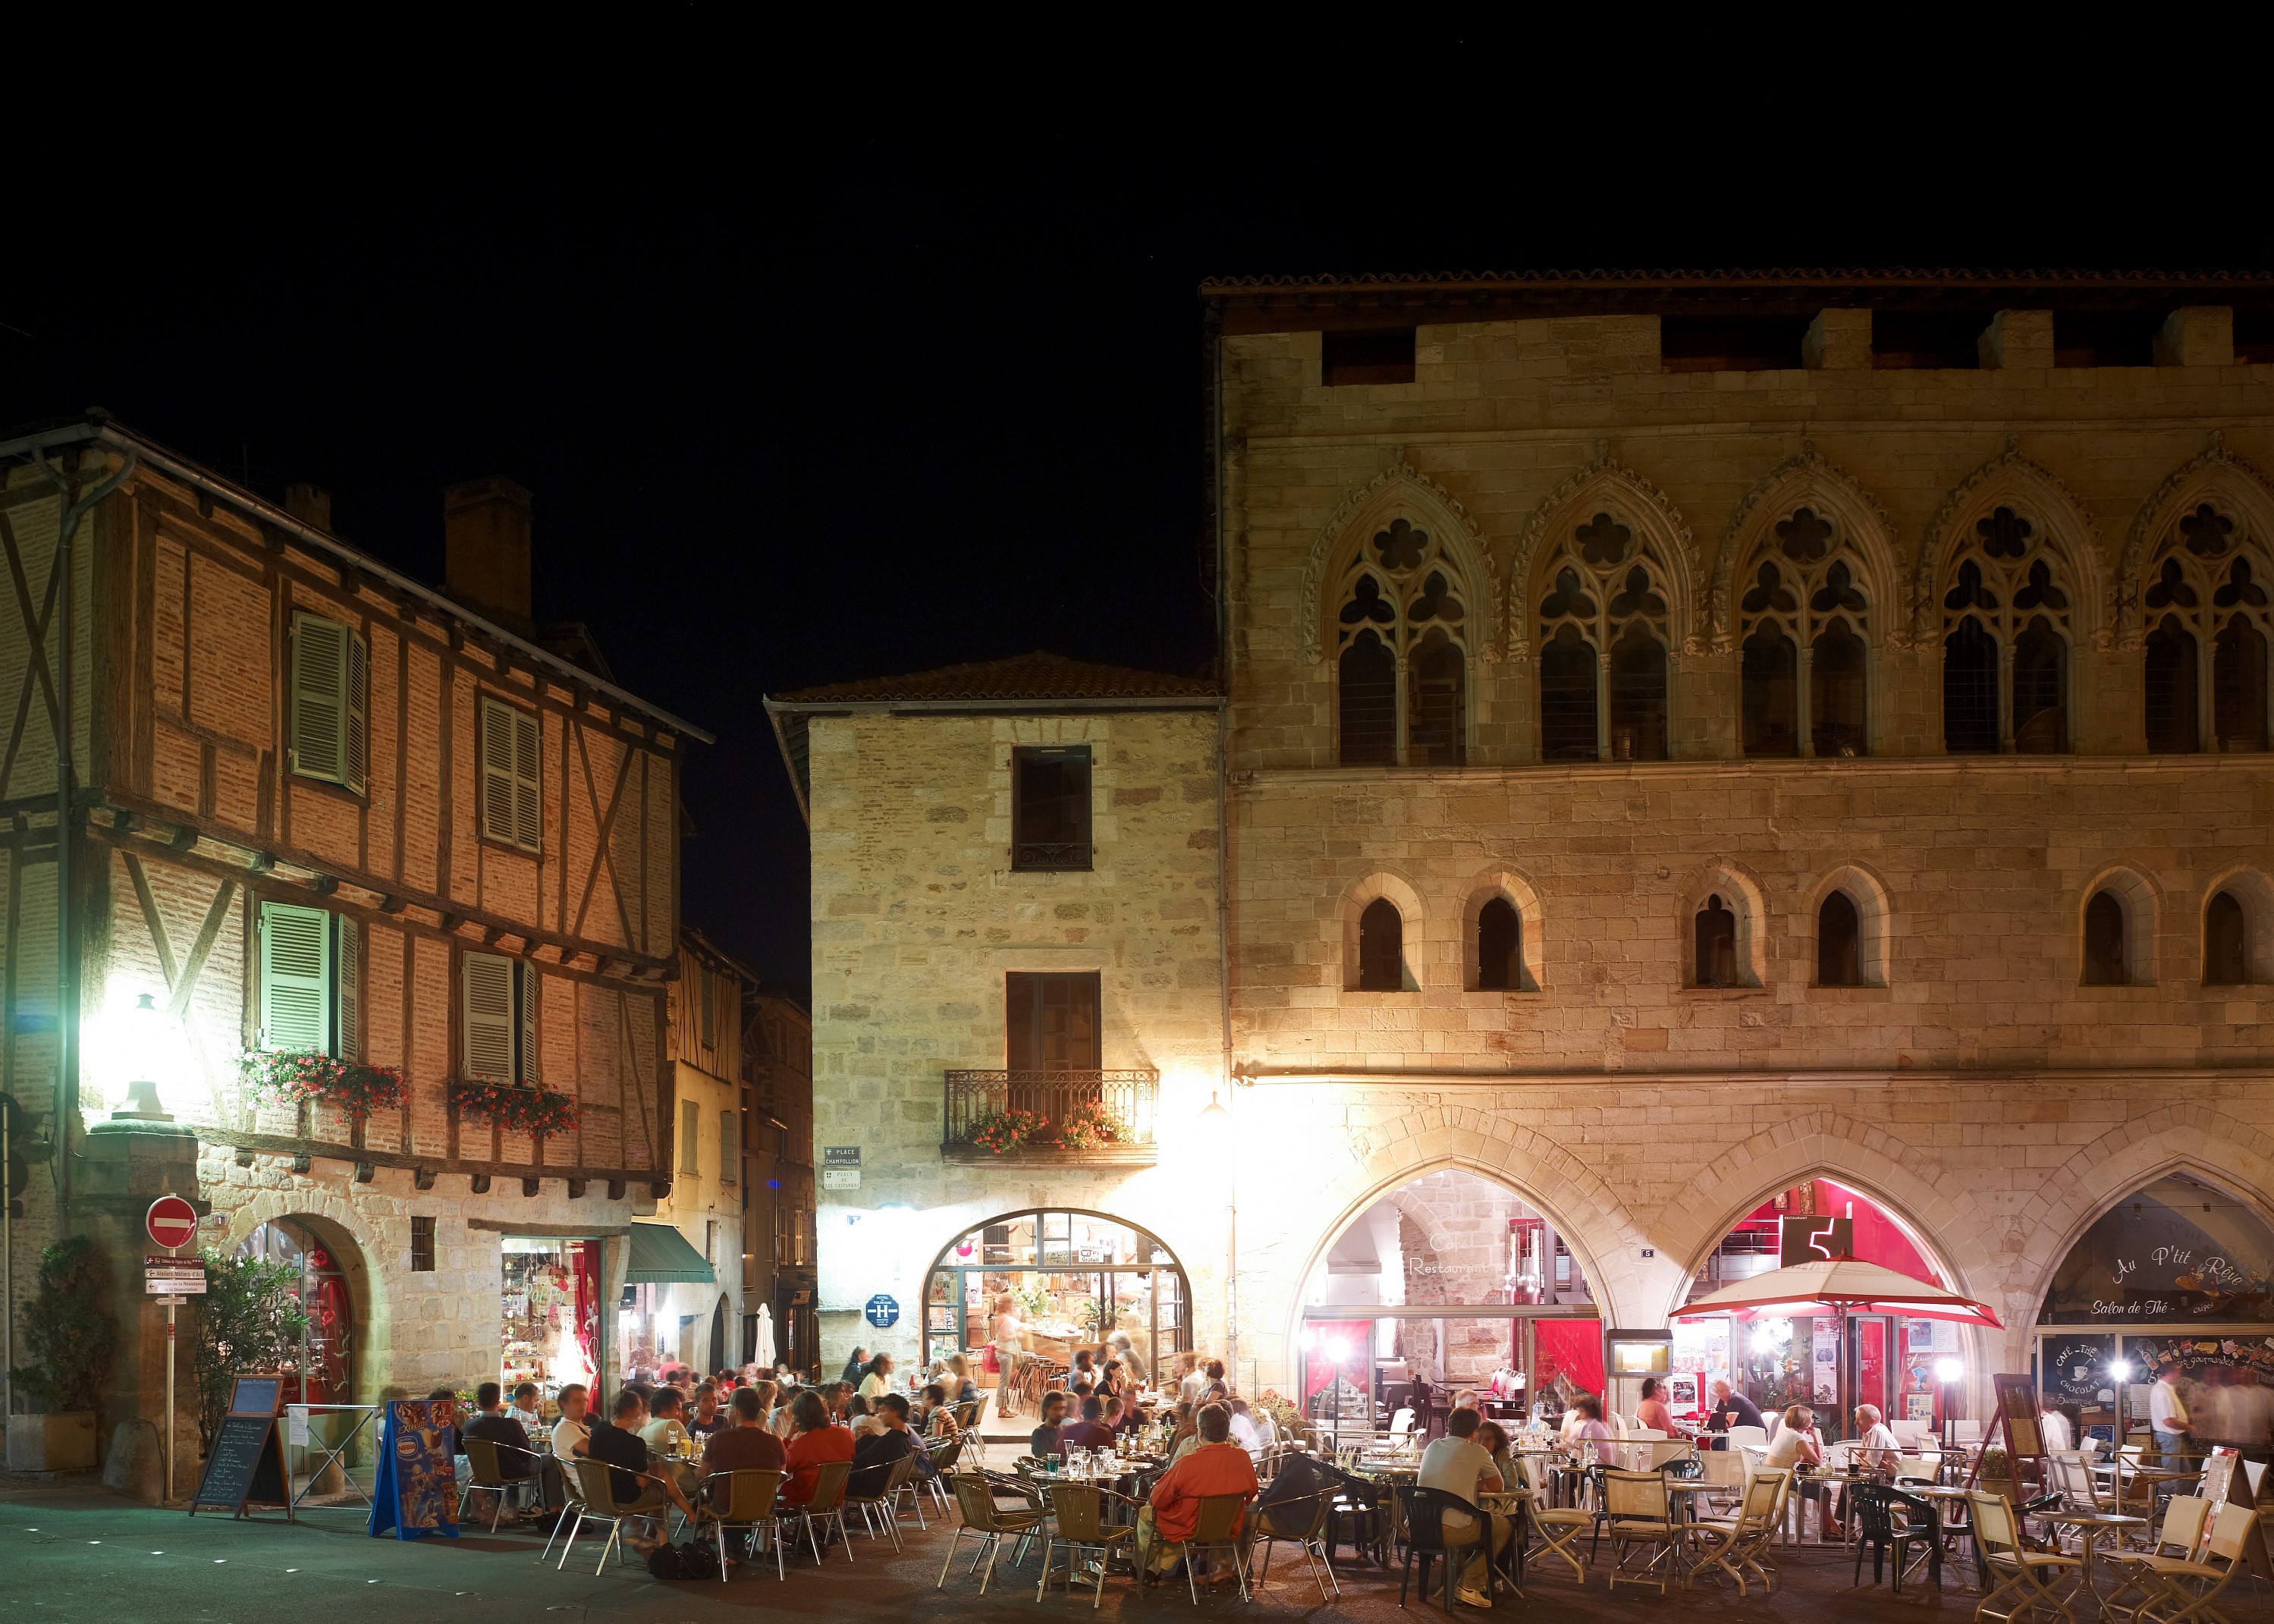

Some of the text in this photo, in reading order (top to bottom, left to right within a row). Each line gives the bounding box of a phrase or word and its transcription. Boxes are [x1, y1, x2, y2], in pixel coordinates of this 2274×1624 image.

[1430, 1233, 1468, 1252] Café
[1409, 1257, 1488, 1276] Restaurant
[2112, 1245, 2243, 1286] Au P'tit Rêve
[876, 1305, 888, 1318] H
[2090, 1299, 2125, 1315] Salon
[2128, 1301, 2141, 1315] de
[2144, 1300, 2168, 1315] Thé
[2056, 1346, 2073, 1367] CAFÉ
[2186, 1355, 2234, 1369] gourmandes
[2060, 1378, 2100, 1394] CHOCOLAT
